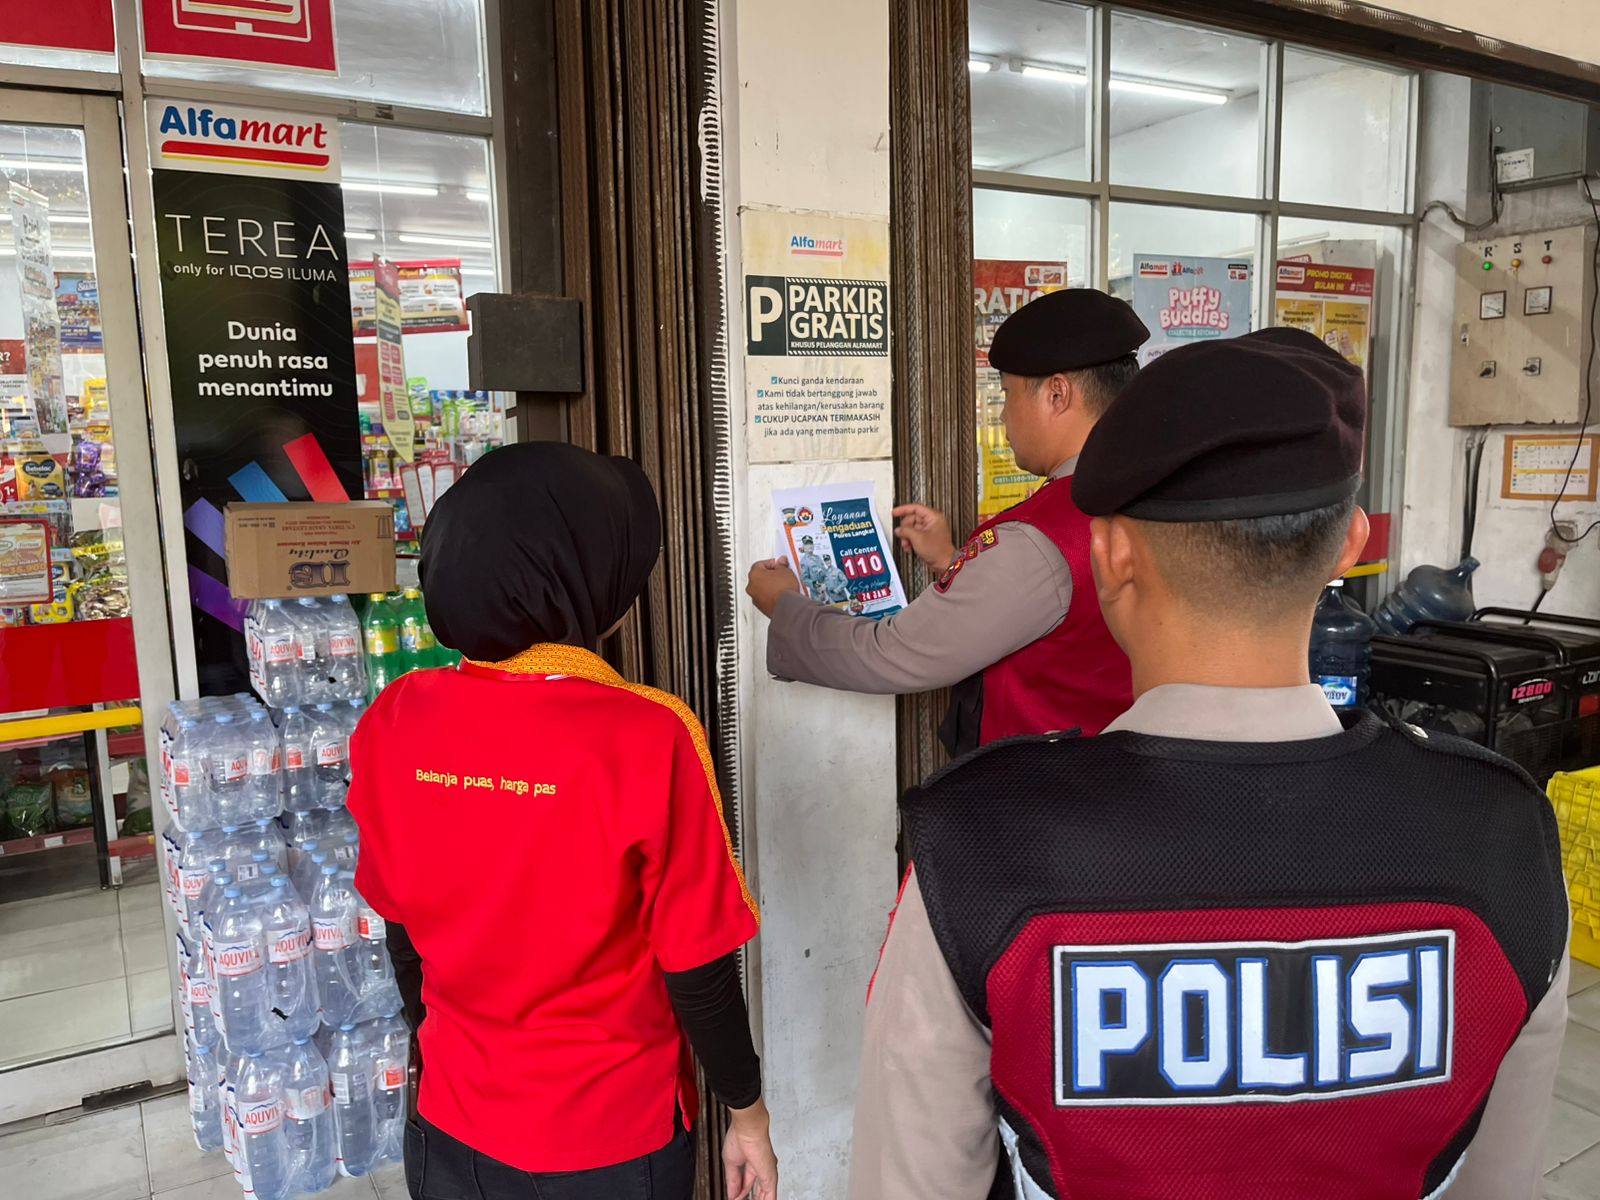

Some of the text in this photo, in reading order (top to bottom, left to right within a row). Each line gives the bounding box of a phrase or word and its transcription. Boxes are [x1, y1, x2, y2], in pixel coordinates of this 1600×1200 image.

[160, 106, 328, 149] Alfamart
[165, 213, 339, 261] TEREA
[791, 235, 843, 250] Alfamart
[1484, 240, 1552, 257] R S T
[173, 263, 202, 277] only
[206, 264, 224, 275] for
[229, 264, 284, 280] IQOS
[287, 268, 337, 282] ILUMA
[1140, 262, 1168, 271] Alfamart
[1306, 268, 1330, 279] PROMO
[789, 285, 884, 314] PARKIR
[1169, 286, 1221, 312] Puffy
[750, 286, 783, 342] P
[1160, 305, 1229, 330] Buddies
[227, 320, 297, 341] Dunia
[789, 311, 884, 340] GRATIS
[198, 349, 328, 373] penuh rasa
[198, 377, 333, 397] menantimu
[801, 378, 824, 387] ganda
[825, 376, 864, 385] kendaraan
[764, 389, 878, 399] Kami tidak bertanggung jawab
[757, 401, 885, 411] atas kehilangan/kerusakan barang
[762, 413, 880, 424] CUKUP UCAPKAN TERIMAKASIH
[764, 425, 879, 438] jika ada yang membantu parkir
[823, 507, 866, 525] Layanan
[821, 521, 872, 532] Pengaduan
[289, 548, 350, 560] Quality
[840, 546, 877, 557] Call Center
[844, 555, 883, 576] 110
[1511, 681, 1552, 699] 12800
[416, 769, 557, 797] Belanja puas, harga pas
[1072, 945, 1442, 1092] POLISI
